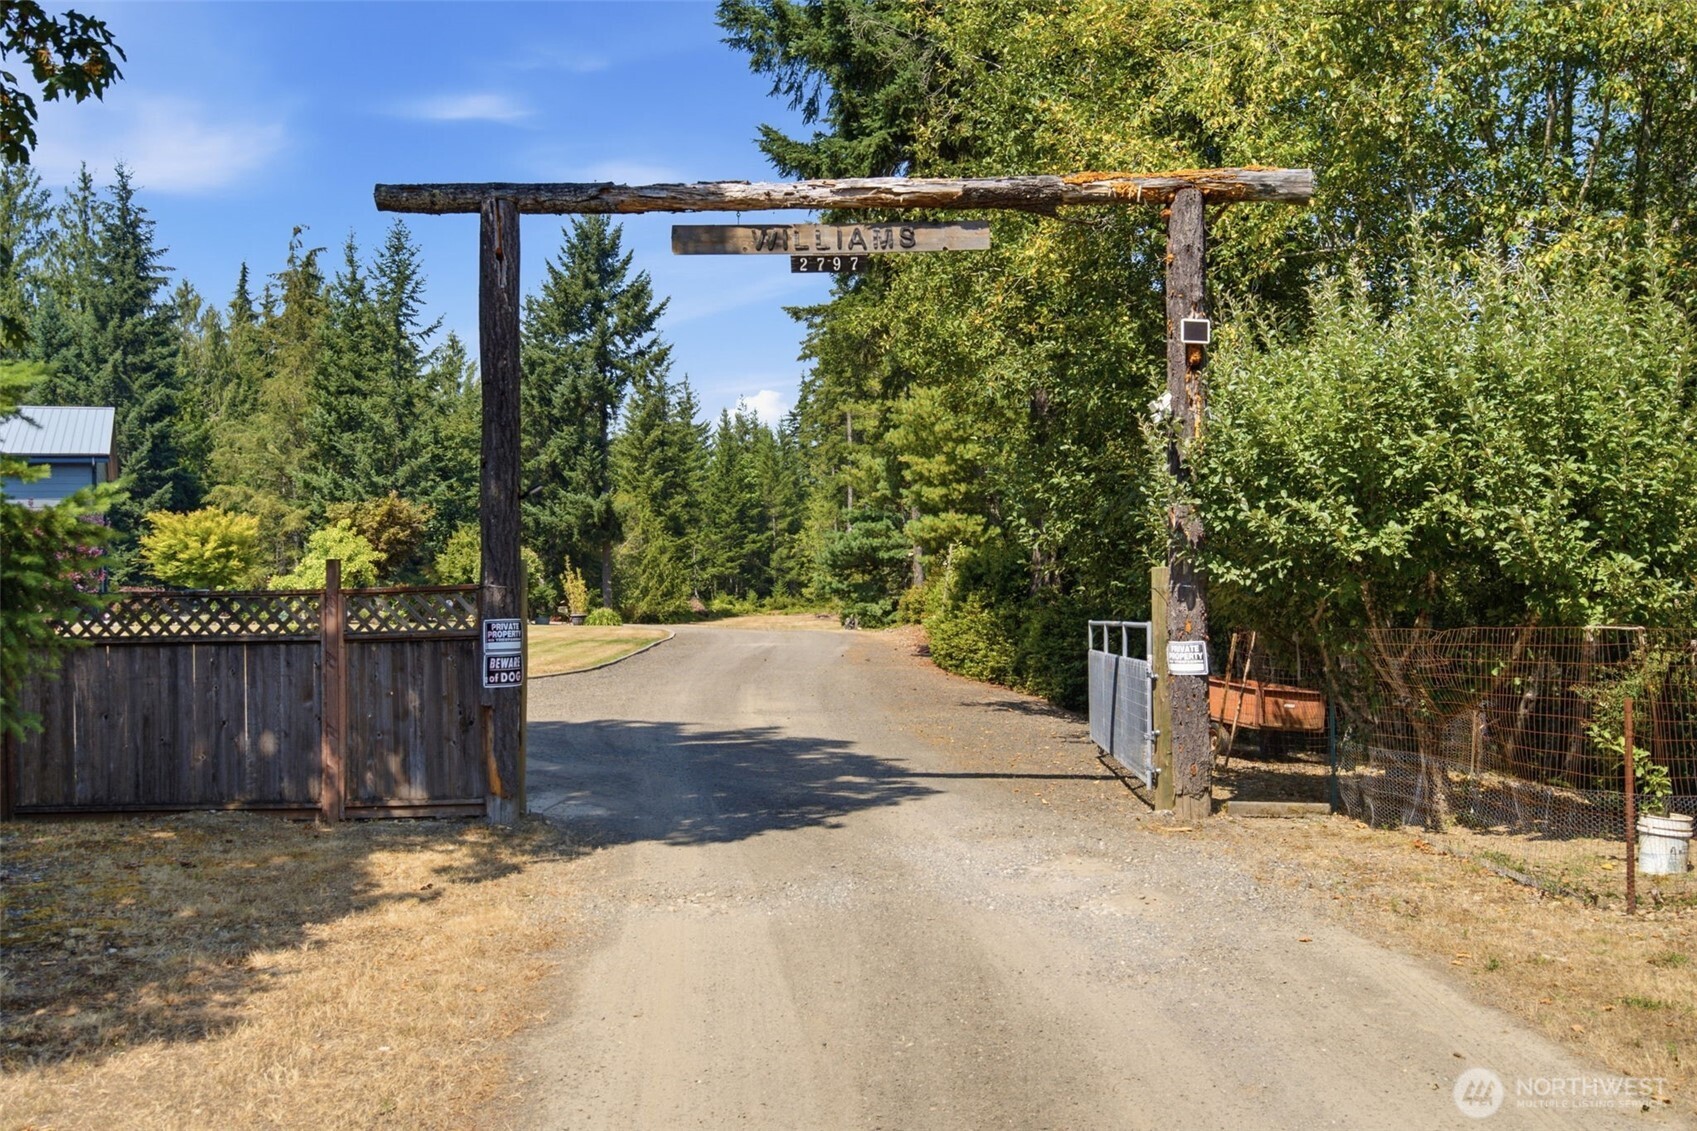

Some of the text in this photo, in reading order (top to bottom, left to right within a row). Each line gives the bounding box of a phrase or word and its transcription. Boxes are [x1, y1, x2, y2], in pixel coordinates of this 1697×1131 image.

[751, 227, 916, 251] WILLIAMS
[491, 623, 520, 631] PRIVATE
[487, 630, 521, 639] PROPERTY
[1171, 645, 1200, 653] PRIVATE
[1169, 652, 1203, 661] PROPERTY
[489, 656, 521, 669] BEWARE
[489, 671, 521, 683] of DOG
